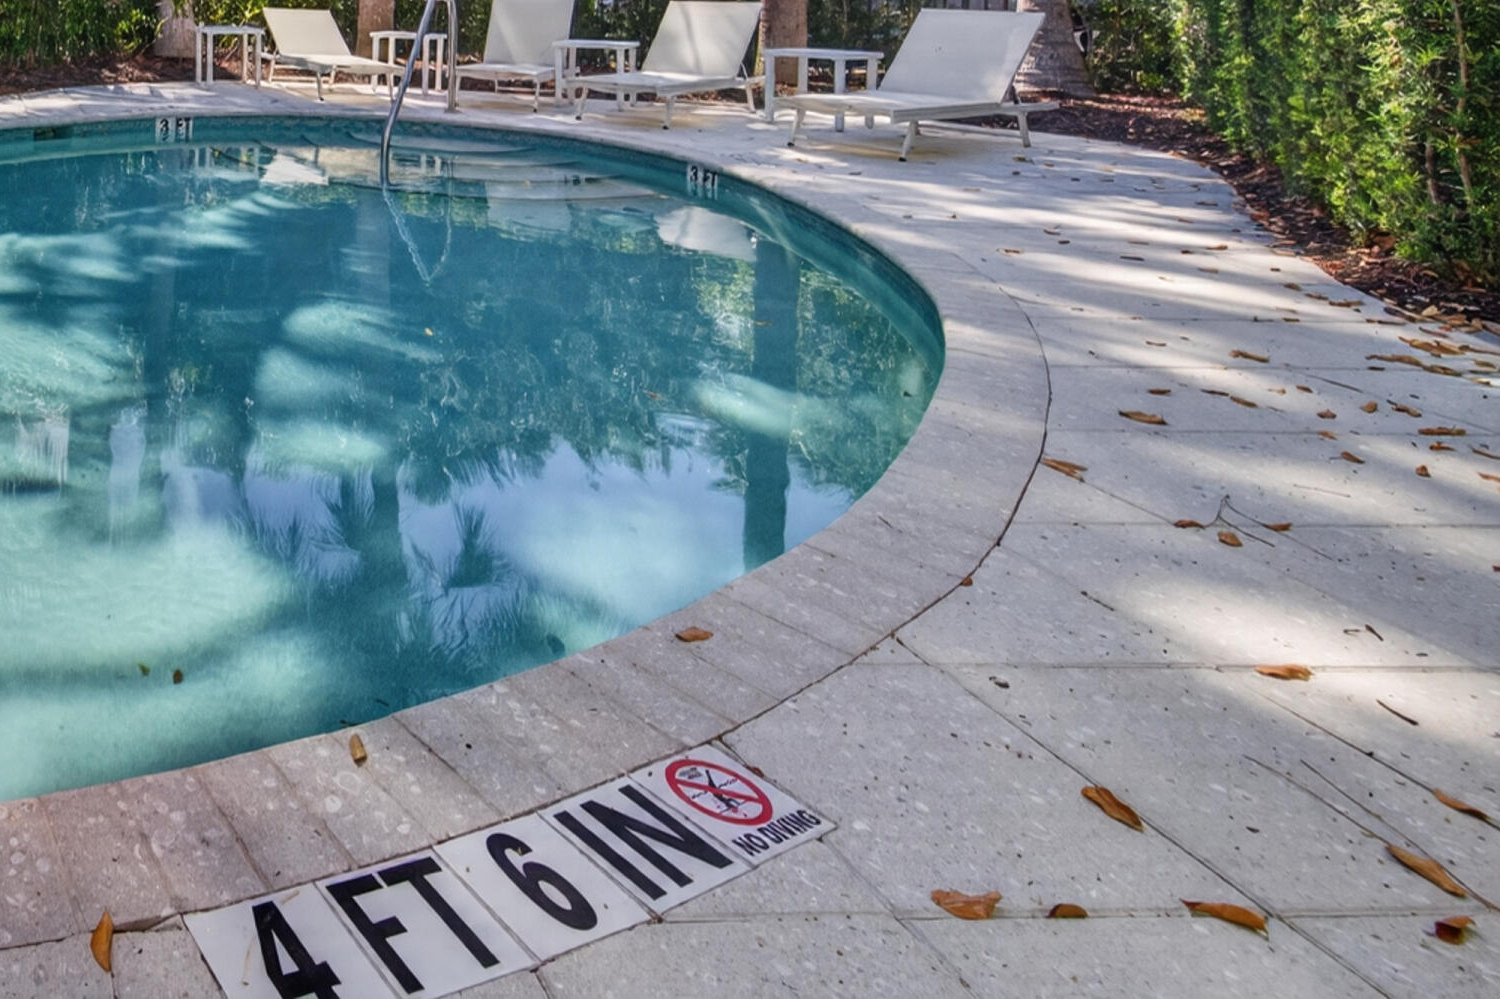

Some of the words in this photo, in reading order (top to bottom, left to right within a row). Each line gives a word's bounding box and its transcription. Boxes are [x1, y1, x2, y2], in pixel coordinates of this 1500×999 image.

[252, 900, 342, 999] 4
[325, 857, 500, 994] FT
[486, 832, 598, 932] 6
[553, 784, 734, 900] IN
[731, 833, 770, 857] NO
[757, 809, 822, 845] DIVING
